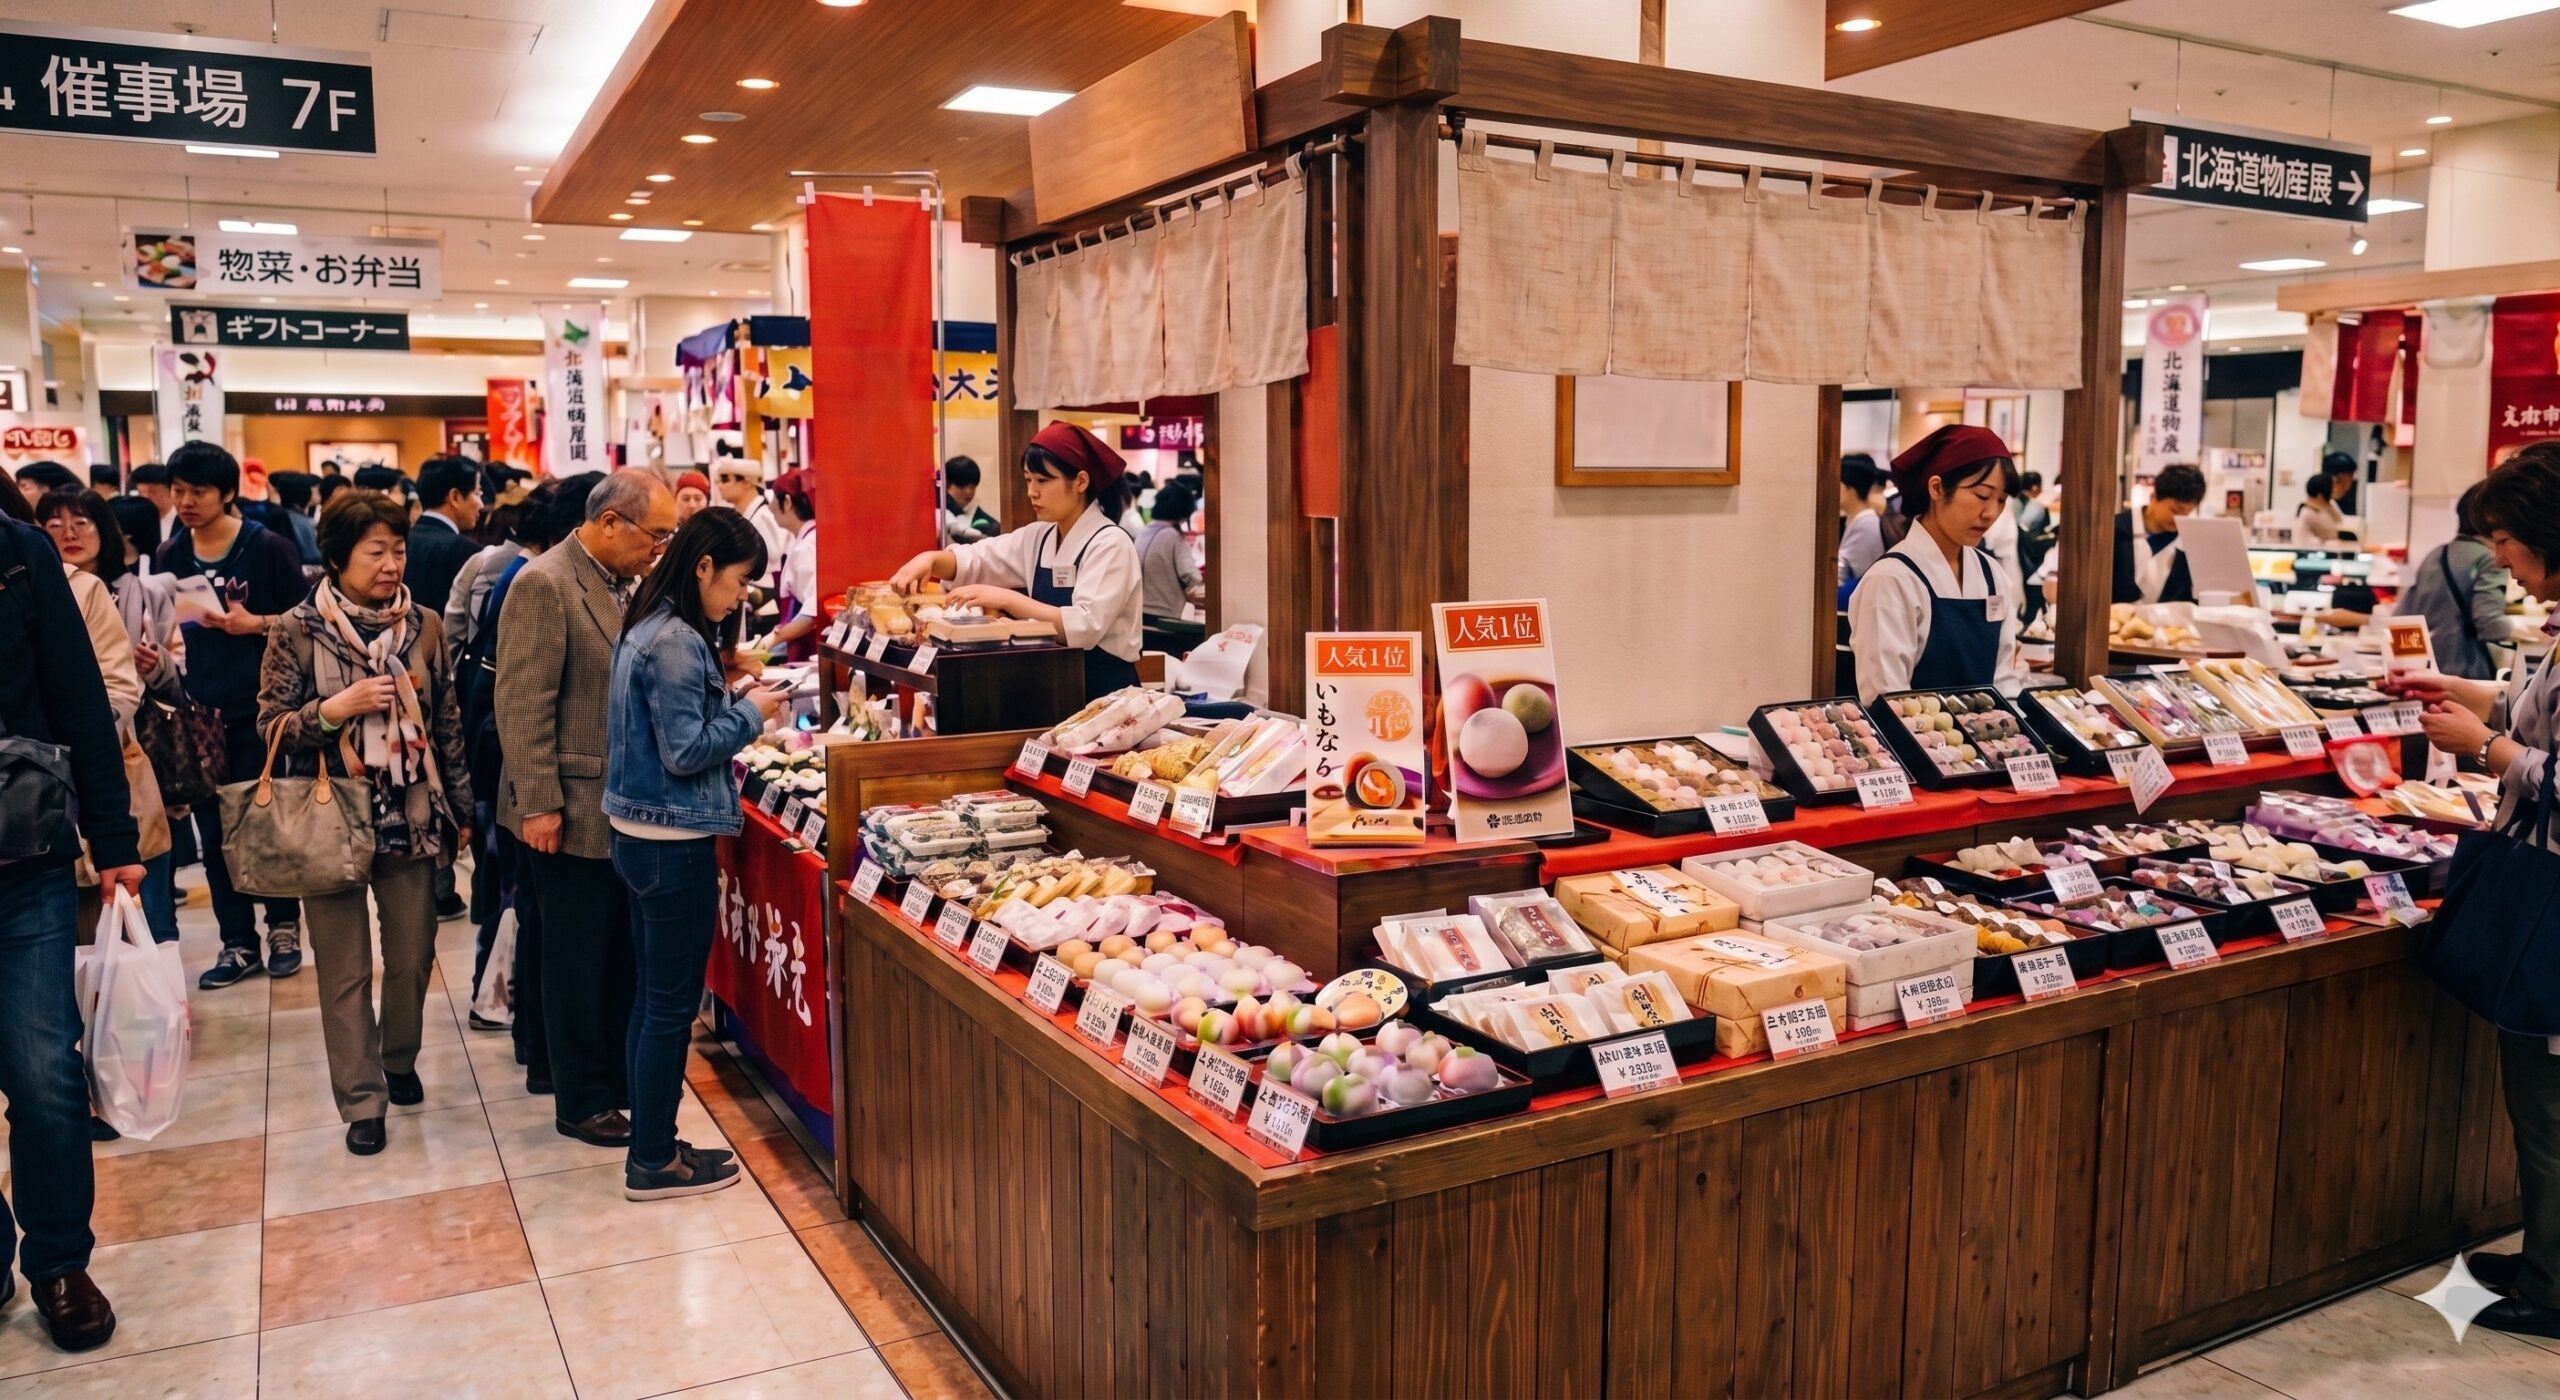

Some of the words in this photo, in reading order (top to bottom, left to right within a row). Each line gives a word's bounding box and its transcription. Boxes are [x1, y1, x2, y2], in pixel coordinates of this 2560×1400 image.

[41, 54, 248, 129] 催事場
[282, 78, 356, 132] 7F
[2181, 142, 2334, 205] 北海道物産展
[218, 249, 422, 289] 惣菜・お弁当
[227, 315, 400, 341] ギフトコーナー
[1454, 613, 1536, 643] 人気1位
[1324, 646, 1407, 668] 人気1位
[1617, 1067, 1626, 1078] ¥
